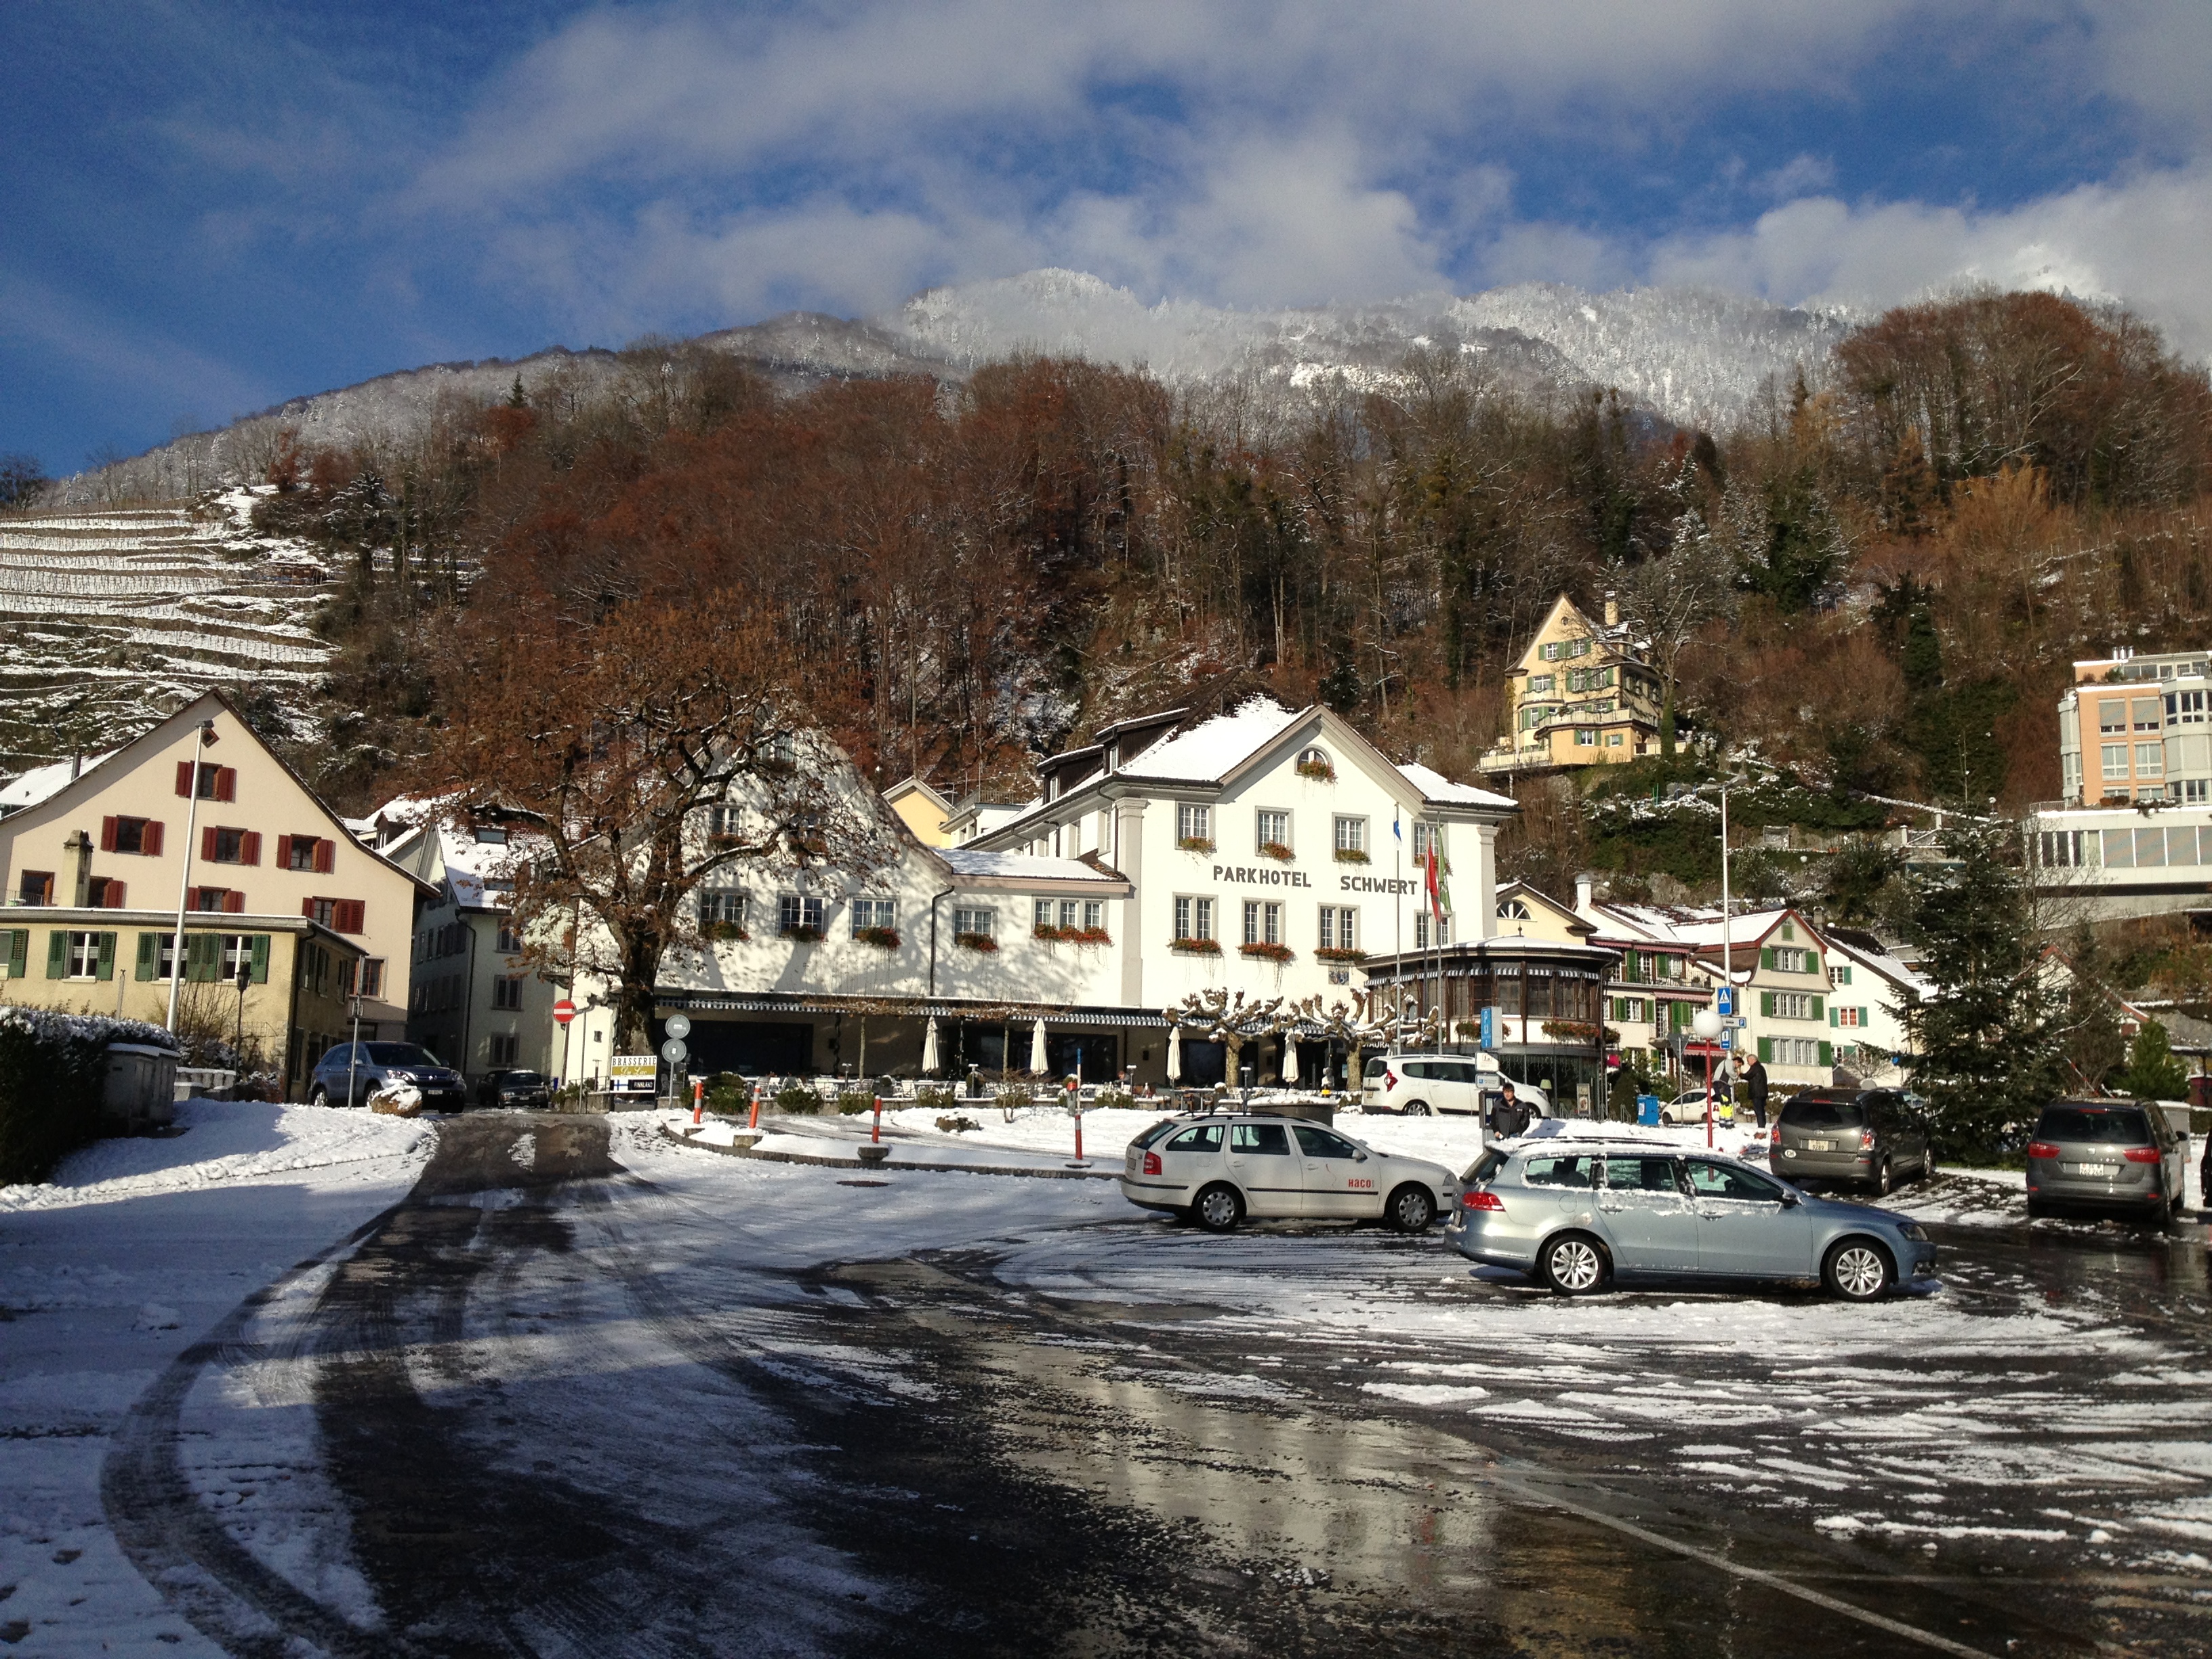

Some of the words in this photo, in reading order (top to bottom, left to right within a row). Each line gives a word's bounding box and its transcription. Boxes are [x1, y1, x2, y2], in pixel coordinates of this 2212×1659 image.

[1213, 865, 1312, 888] PARKHOTEL
[1340, 875, 1418, 895] SCHWERT
[613, 1057, 656, 1066] BRASSERIE
